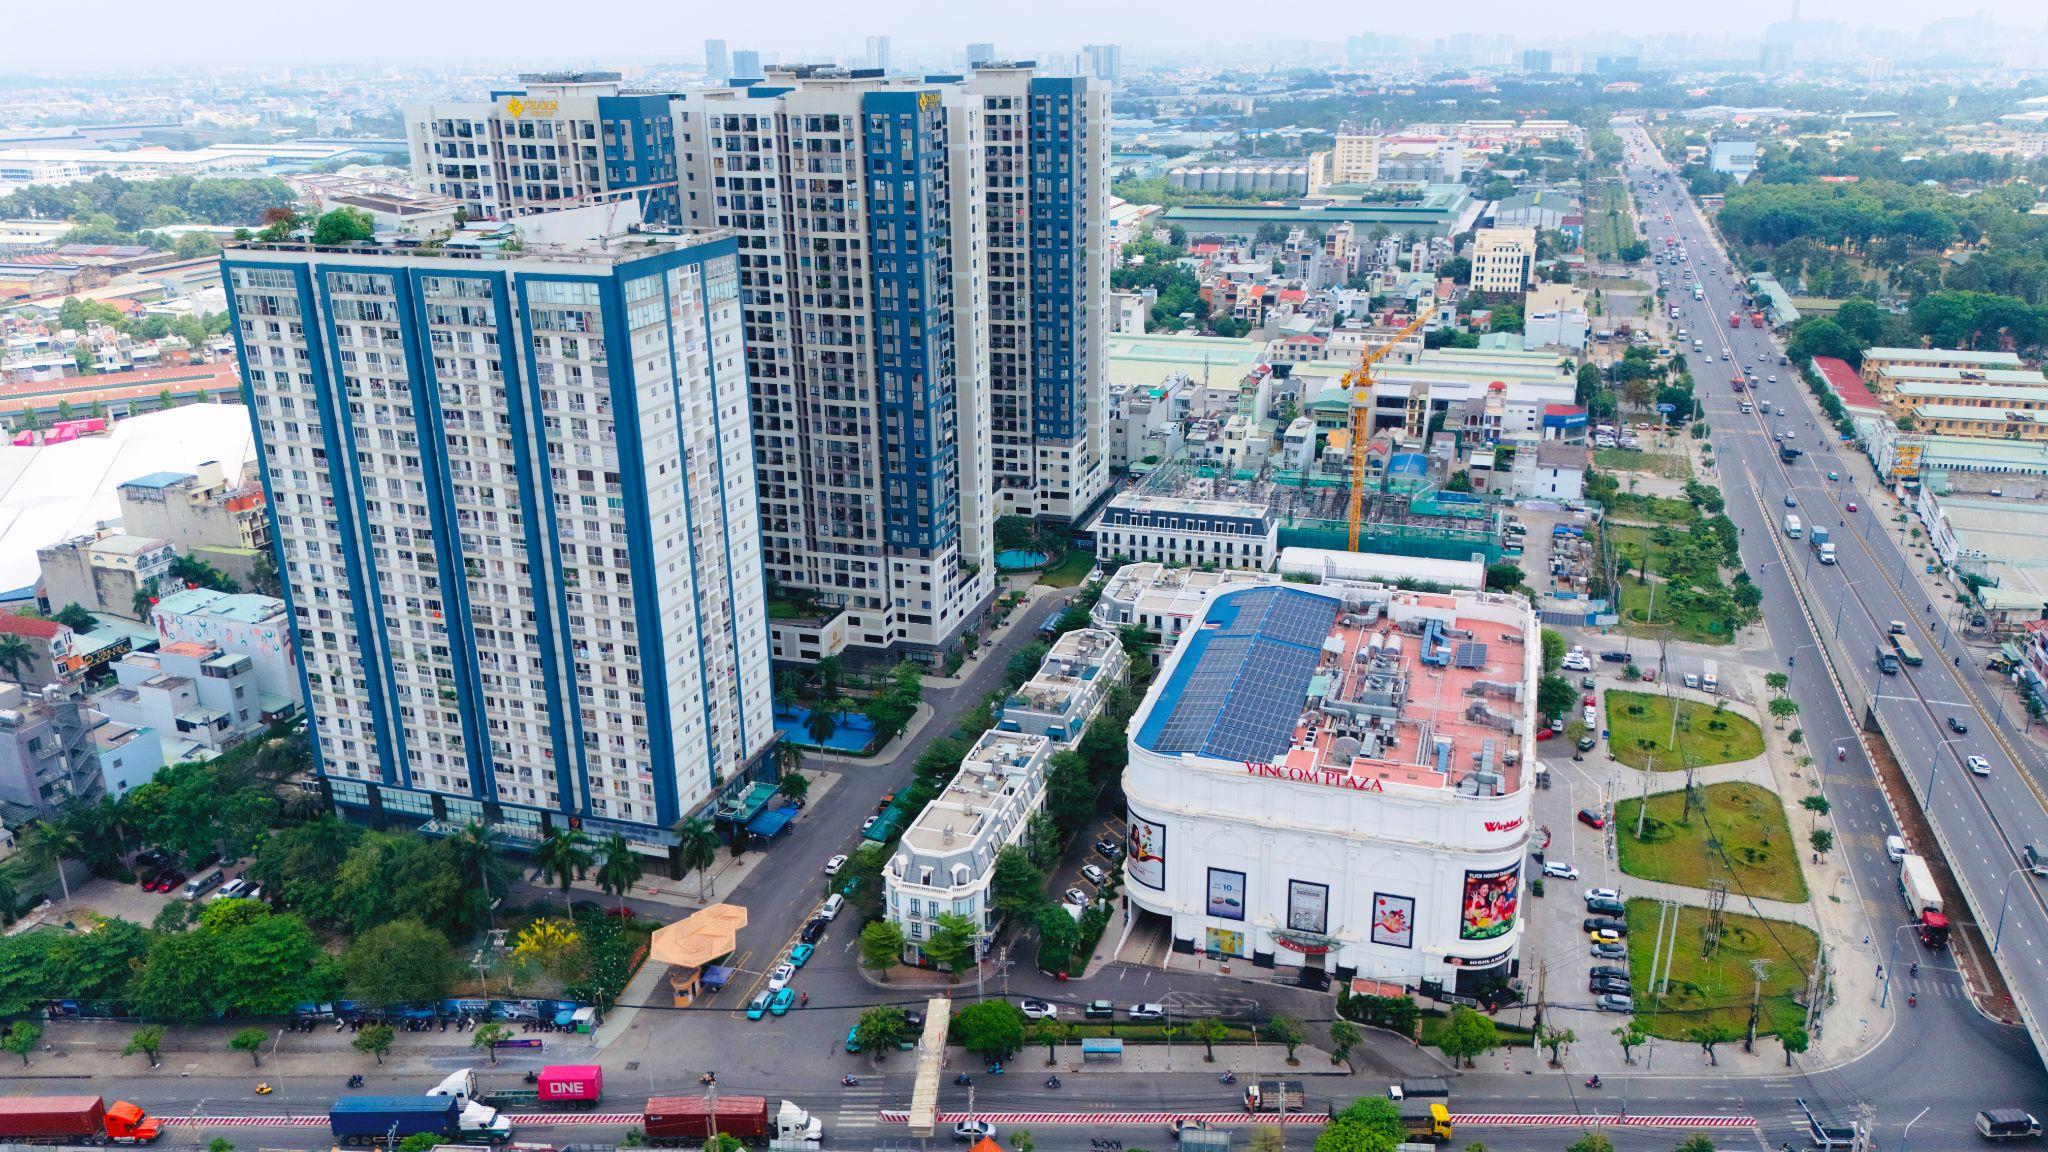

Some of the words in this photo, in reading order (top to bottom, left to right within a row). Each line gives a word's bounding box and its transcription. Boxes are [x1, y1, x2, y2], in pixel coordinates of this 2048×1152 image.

[1244, 760, 1319, 783] VINCOM
[1325, 771, 1384, 792] PLAZA
[1484, 815, 1523, 832] WinMart
[1223, 884, 1232, 892] 10
[549, 1082, 584, 1094] ONE
